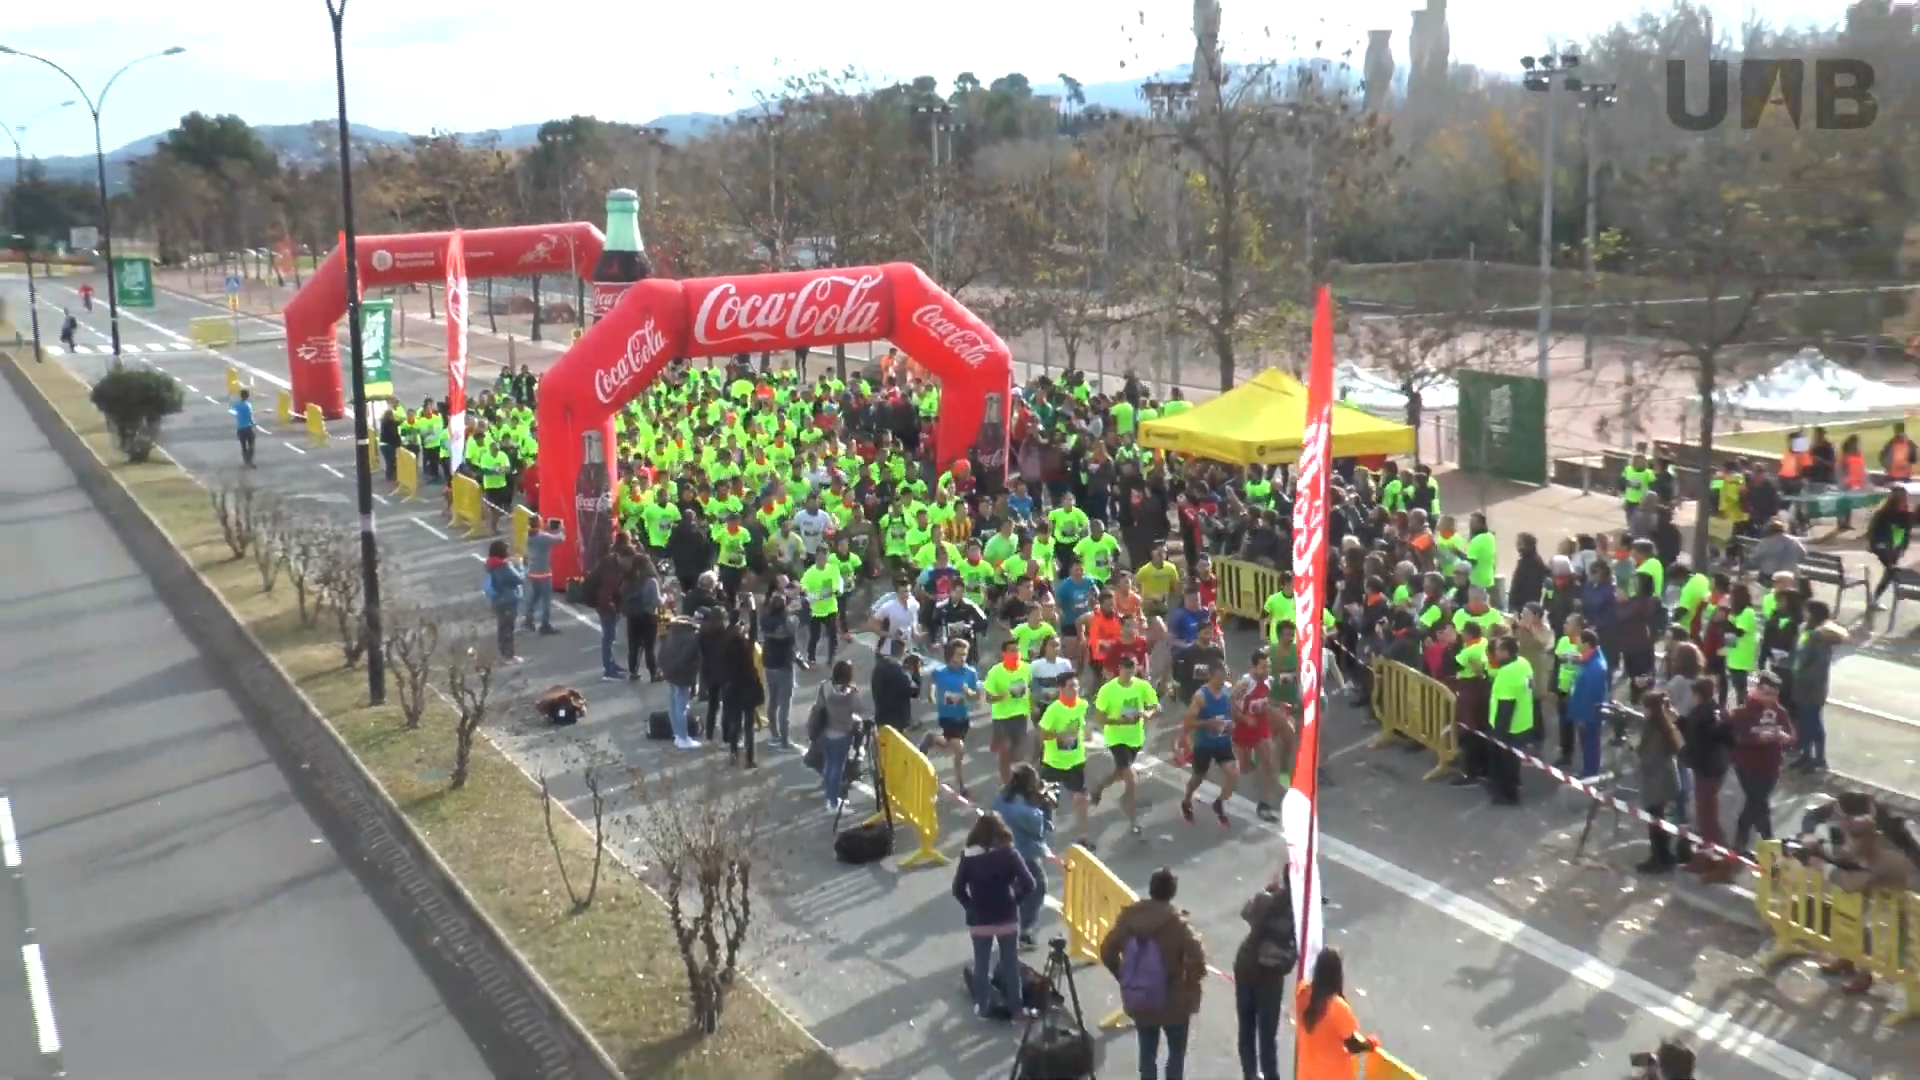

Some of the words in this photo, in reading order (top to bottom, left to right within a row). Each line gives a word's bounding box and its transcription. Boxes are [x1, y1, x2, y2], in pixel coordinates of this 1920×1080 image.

[694, 273, 884, 346] Coca-Cola
[911, 304, 995, 370] Coca-Cola
[594, 316, 669, 404] Coca-Cola
